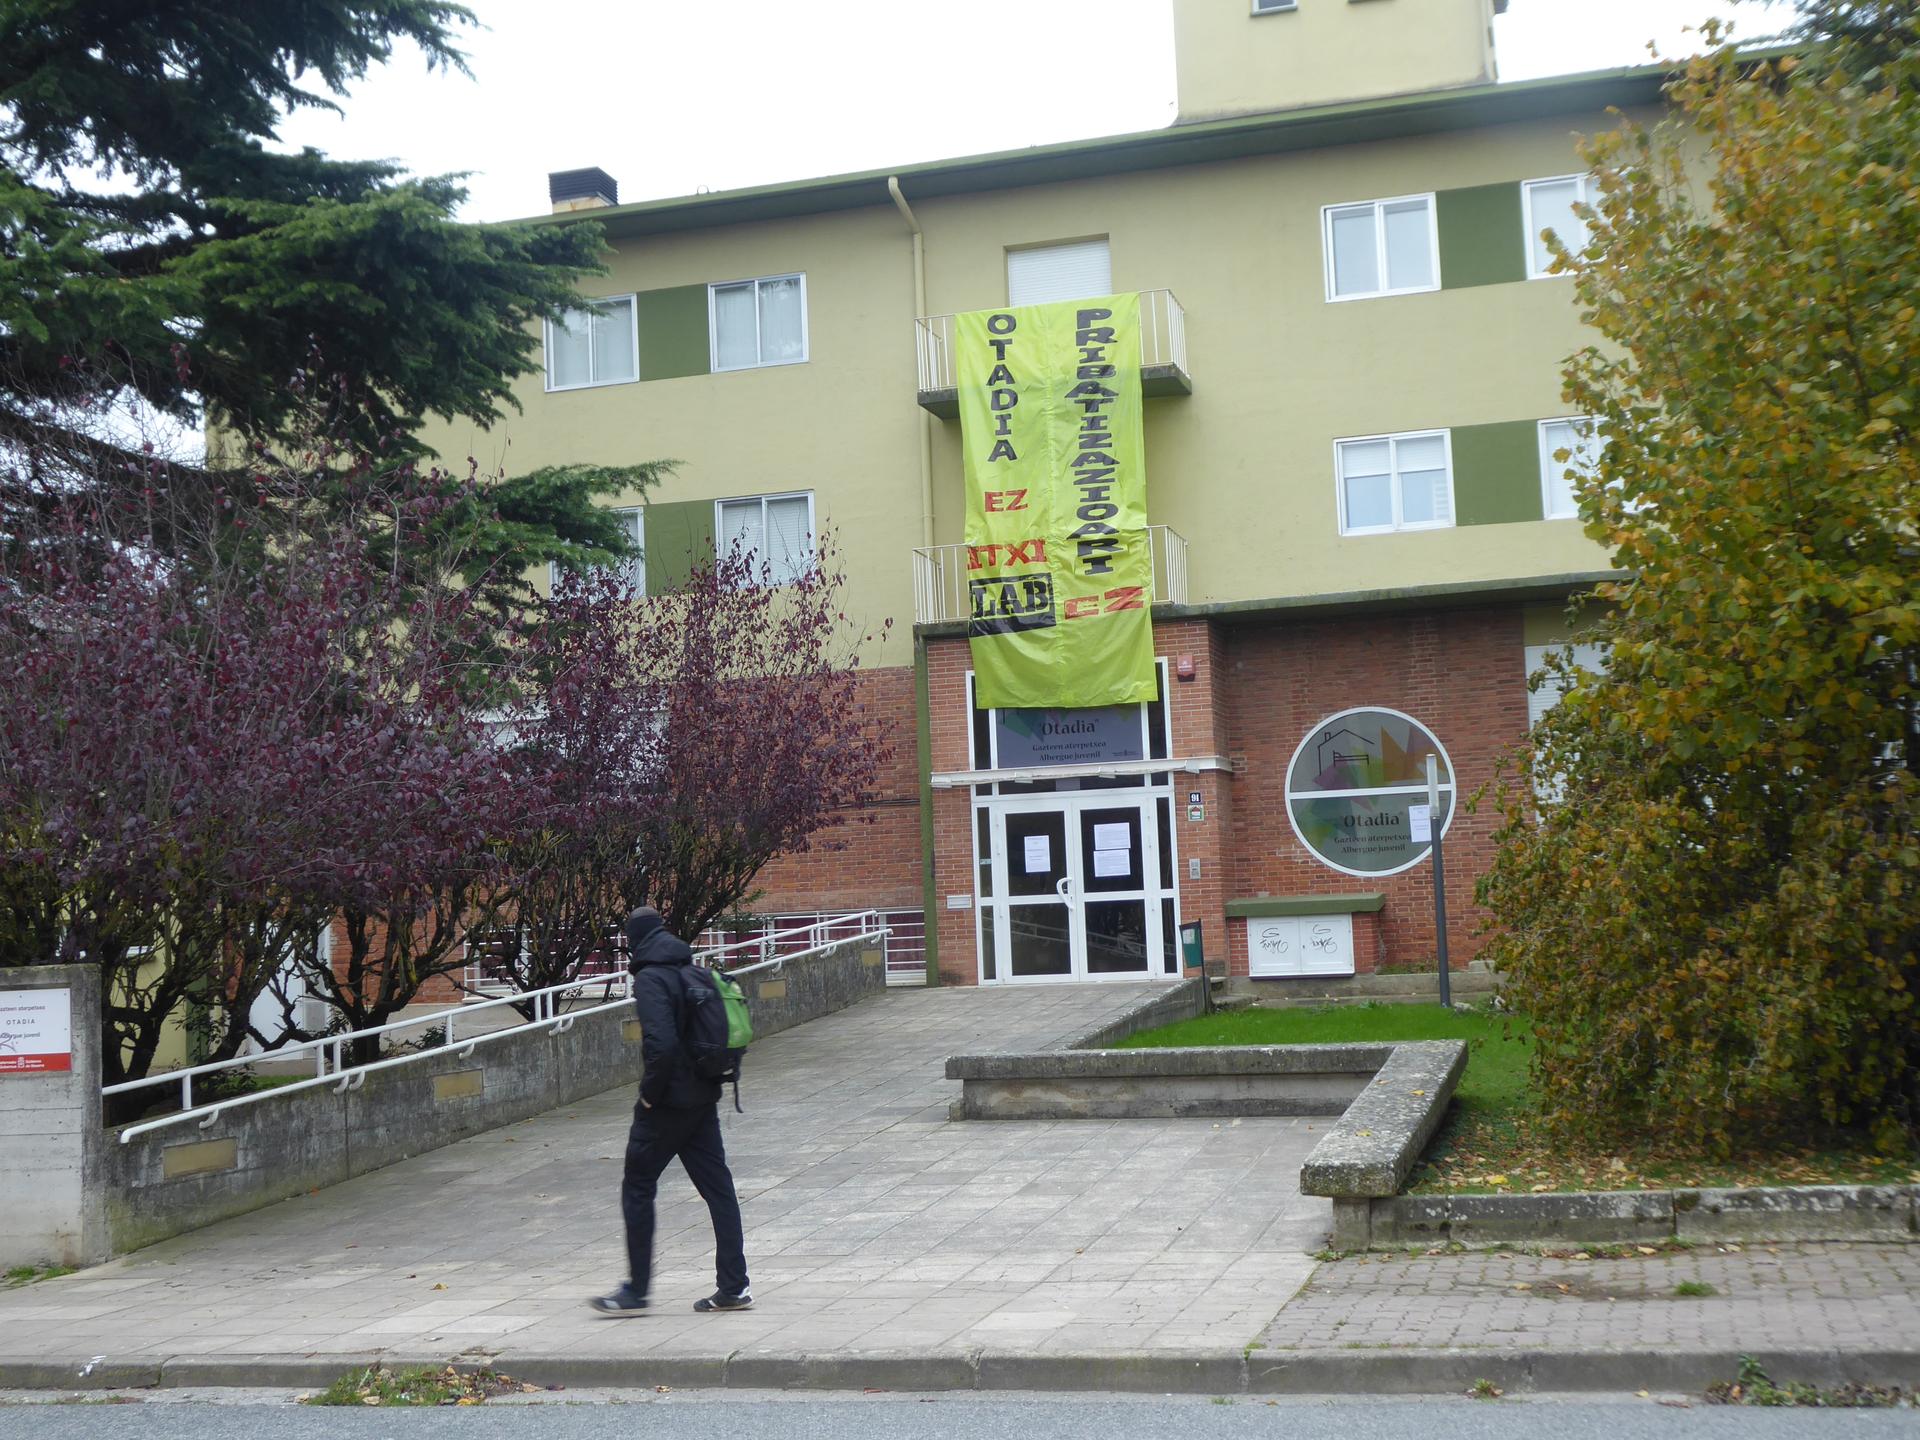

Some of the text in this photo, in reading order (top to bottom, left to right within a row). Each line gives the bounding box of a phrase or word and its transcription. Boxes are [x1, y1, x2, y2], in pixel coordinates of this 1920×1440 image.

[986, 314, 1018, 462] OTADIA
[1064, 308, 1124, 576] PRIBATIZAZIOARI
[984, 488, 1028, 513] EZ
[968, 538, 1047, 570] ITXI
[971, 580, 1049, 619] LAB
[1190, 793, 1199, 802] 91
[6, 1018, 36, 1026] OTADIA
